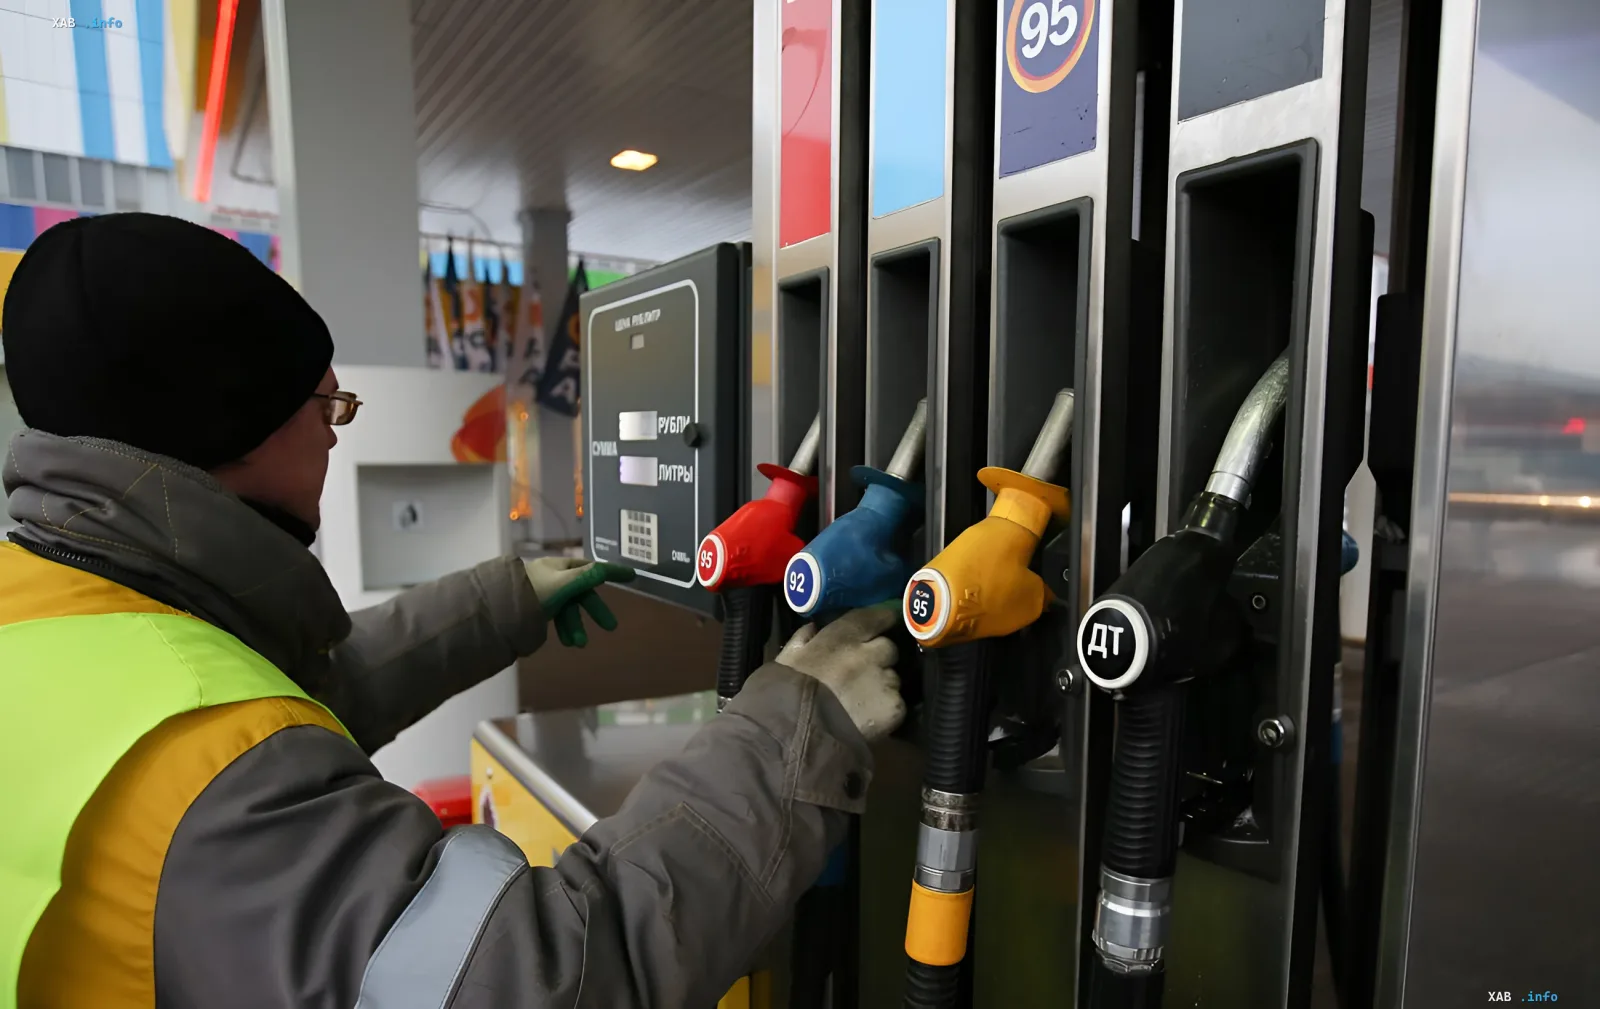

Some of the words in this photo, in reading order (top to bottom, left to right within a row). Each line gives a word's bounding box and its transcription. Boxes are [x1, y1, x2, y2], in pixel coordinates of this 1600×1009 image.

[1021, 0, 1078, 59] 95
[659, 463, 693, 483] ЛИТРЫ
[701, 549, 713, 569] 95
[789, 571, 805, 593] 92
[912, 598, 928, 617] 95
[1087, 622, 1124, 659] ДТ
